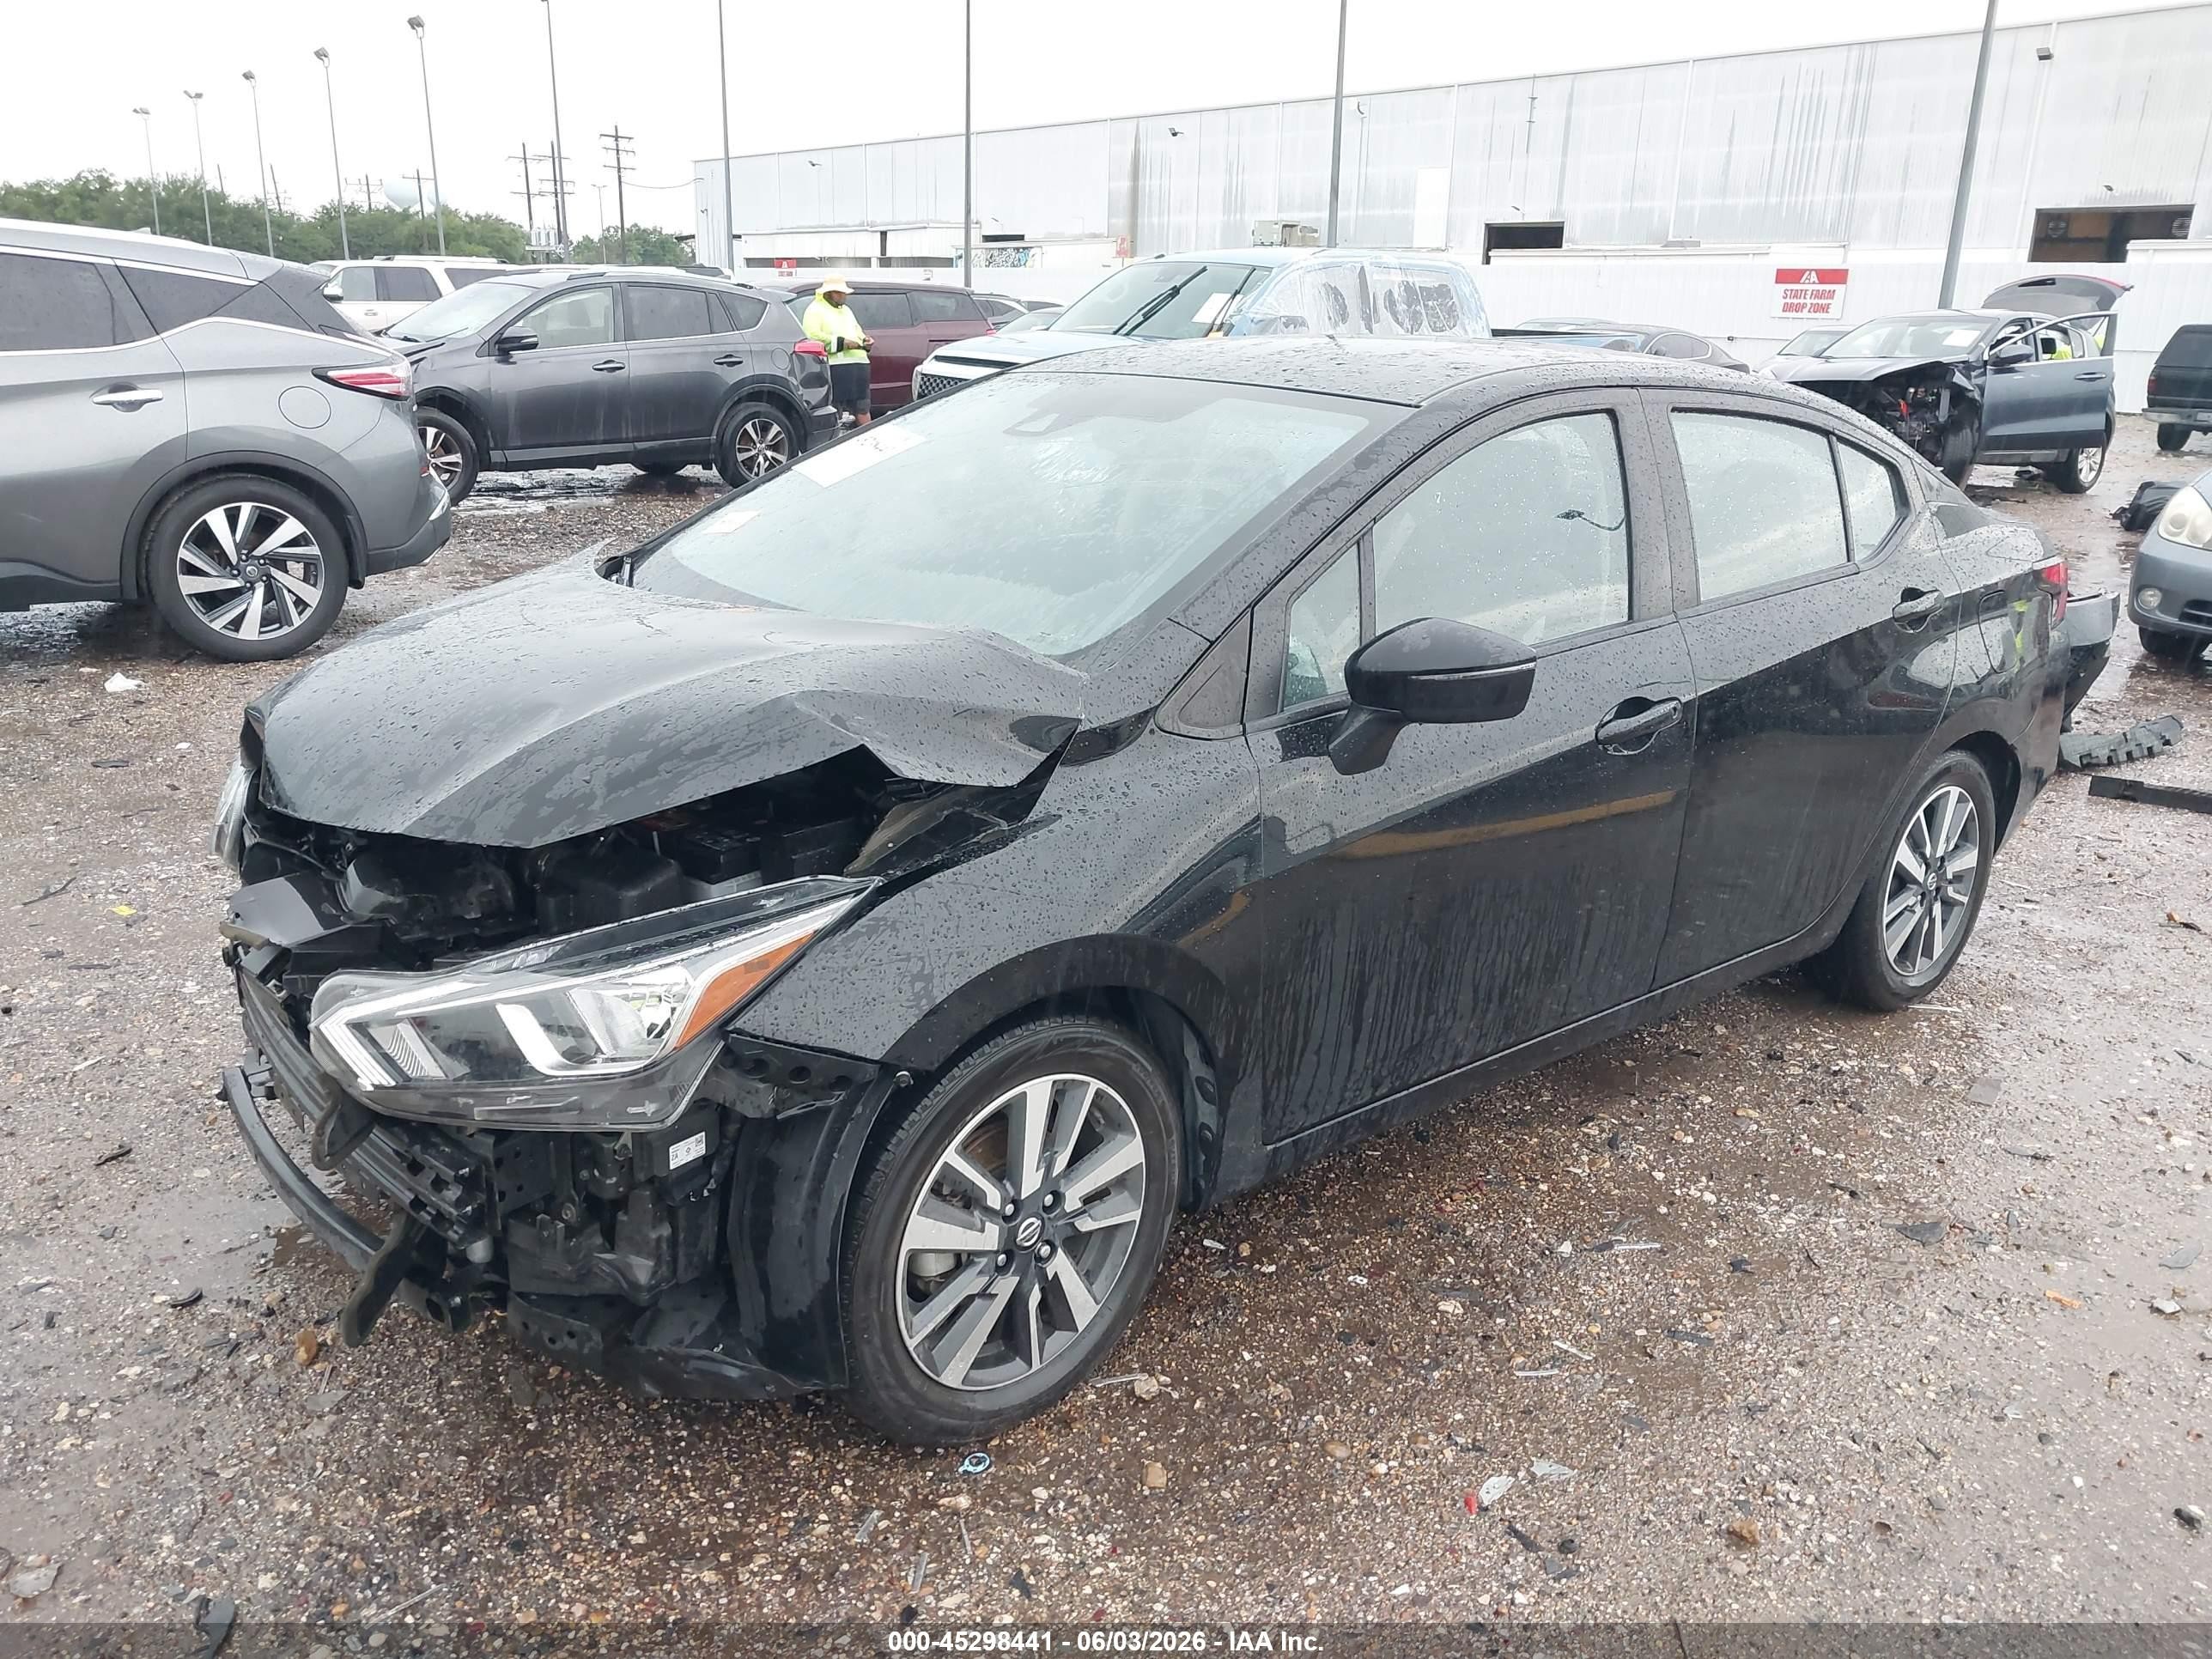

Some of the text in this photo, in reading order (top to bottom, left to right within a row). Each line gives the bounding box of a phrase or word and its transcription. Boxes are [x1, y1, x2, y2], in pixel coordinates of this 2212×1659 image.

[1782, 289, 1836, 301] STATE FARM
[1782, 302, 1832, 313] DROP ZONE
